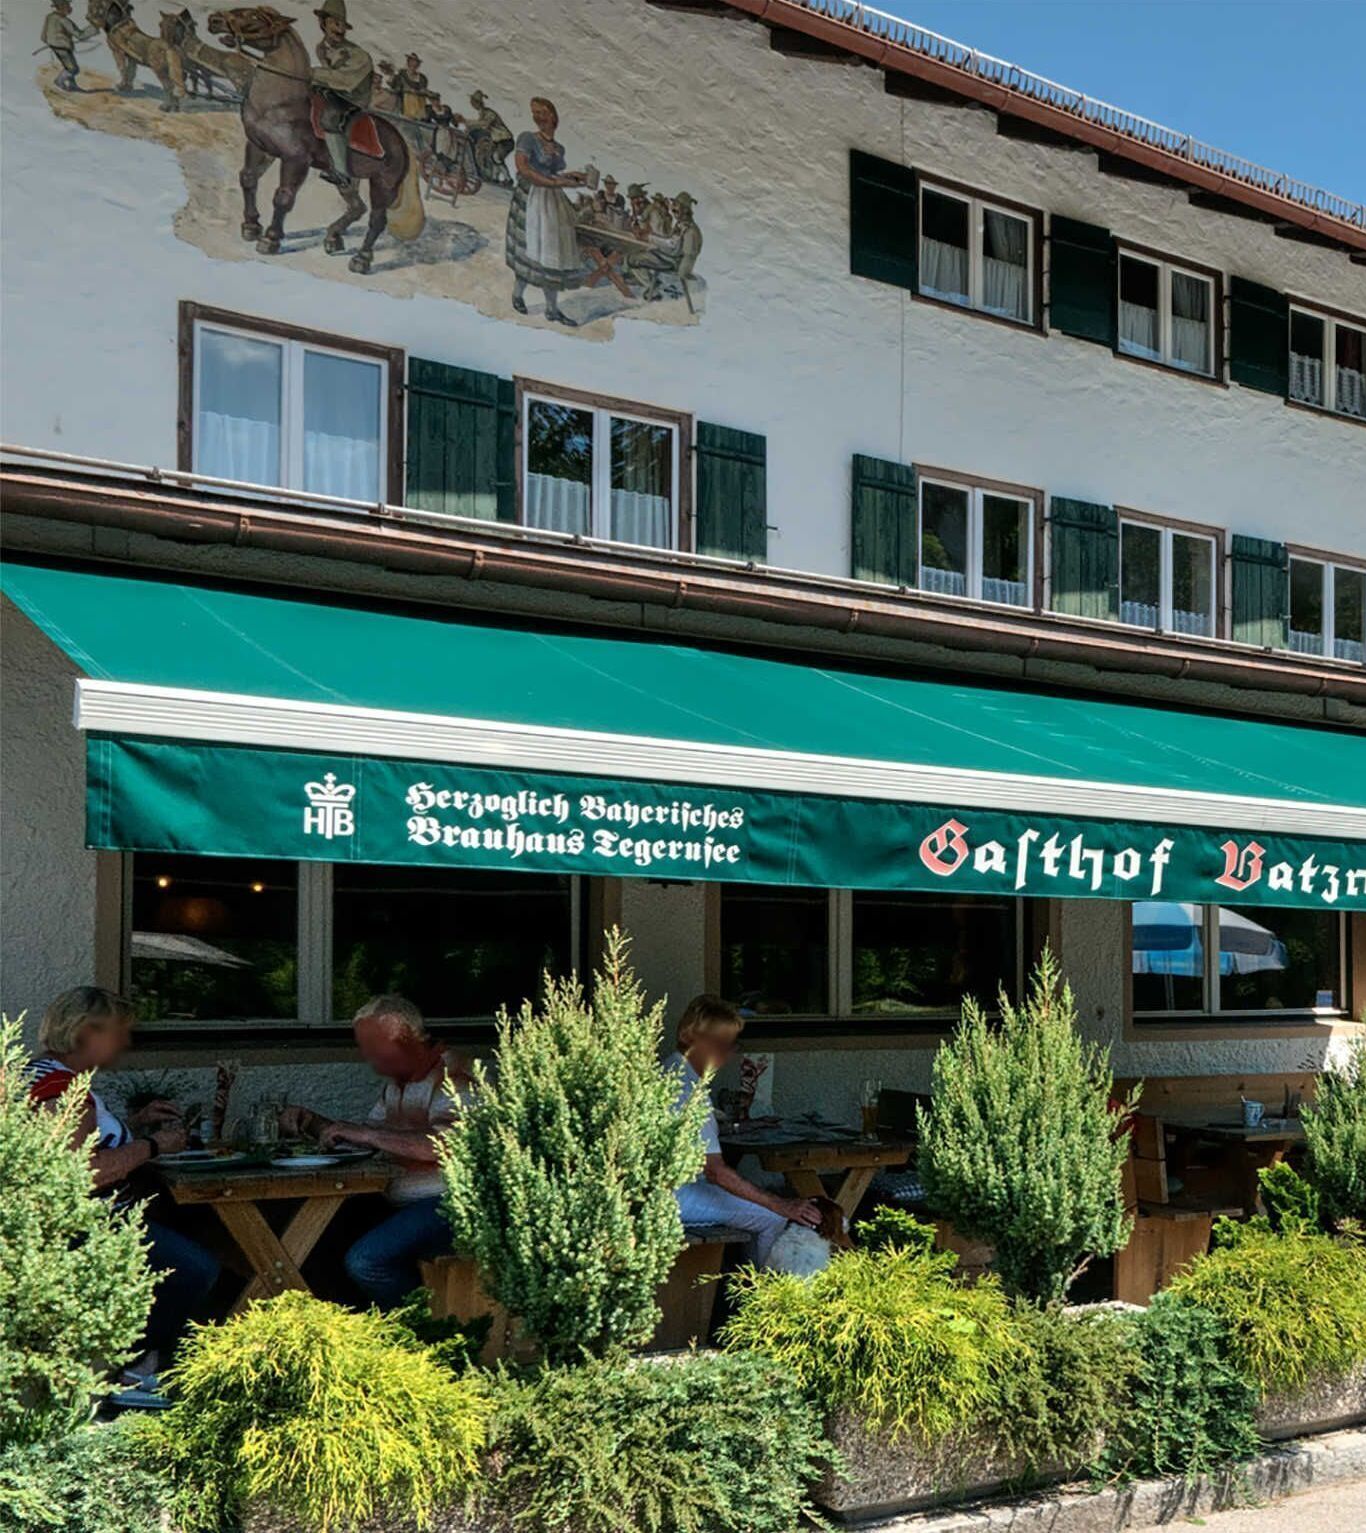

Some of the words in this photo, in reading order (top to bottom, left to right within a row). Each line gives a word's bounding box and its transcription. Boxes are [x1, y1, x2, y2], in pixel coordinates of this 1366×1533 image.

[405, 781, 569, 822] Herzoglich
[407, 815, 585, 859] Brauhaus
[918, 817, 1174, 895] Gasthof
